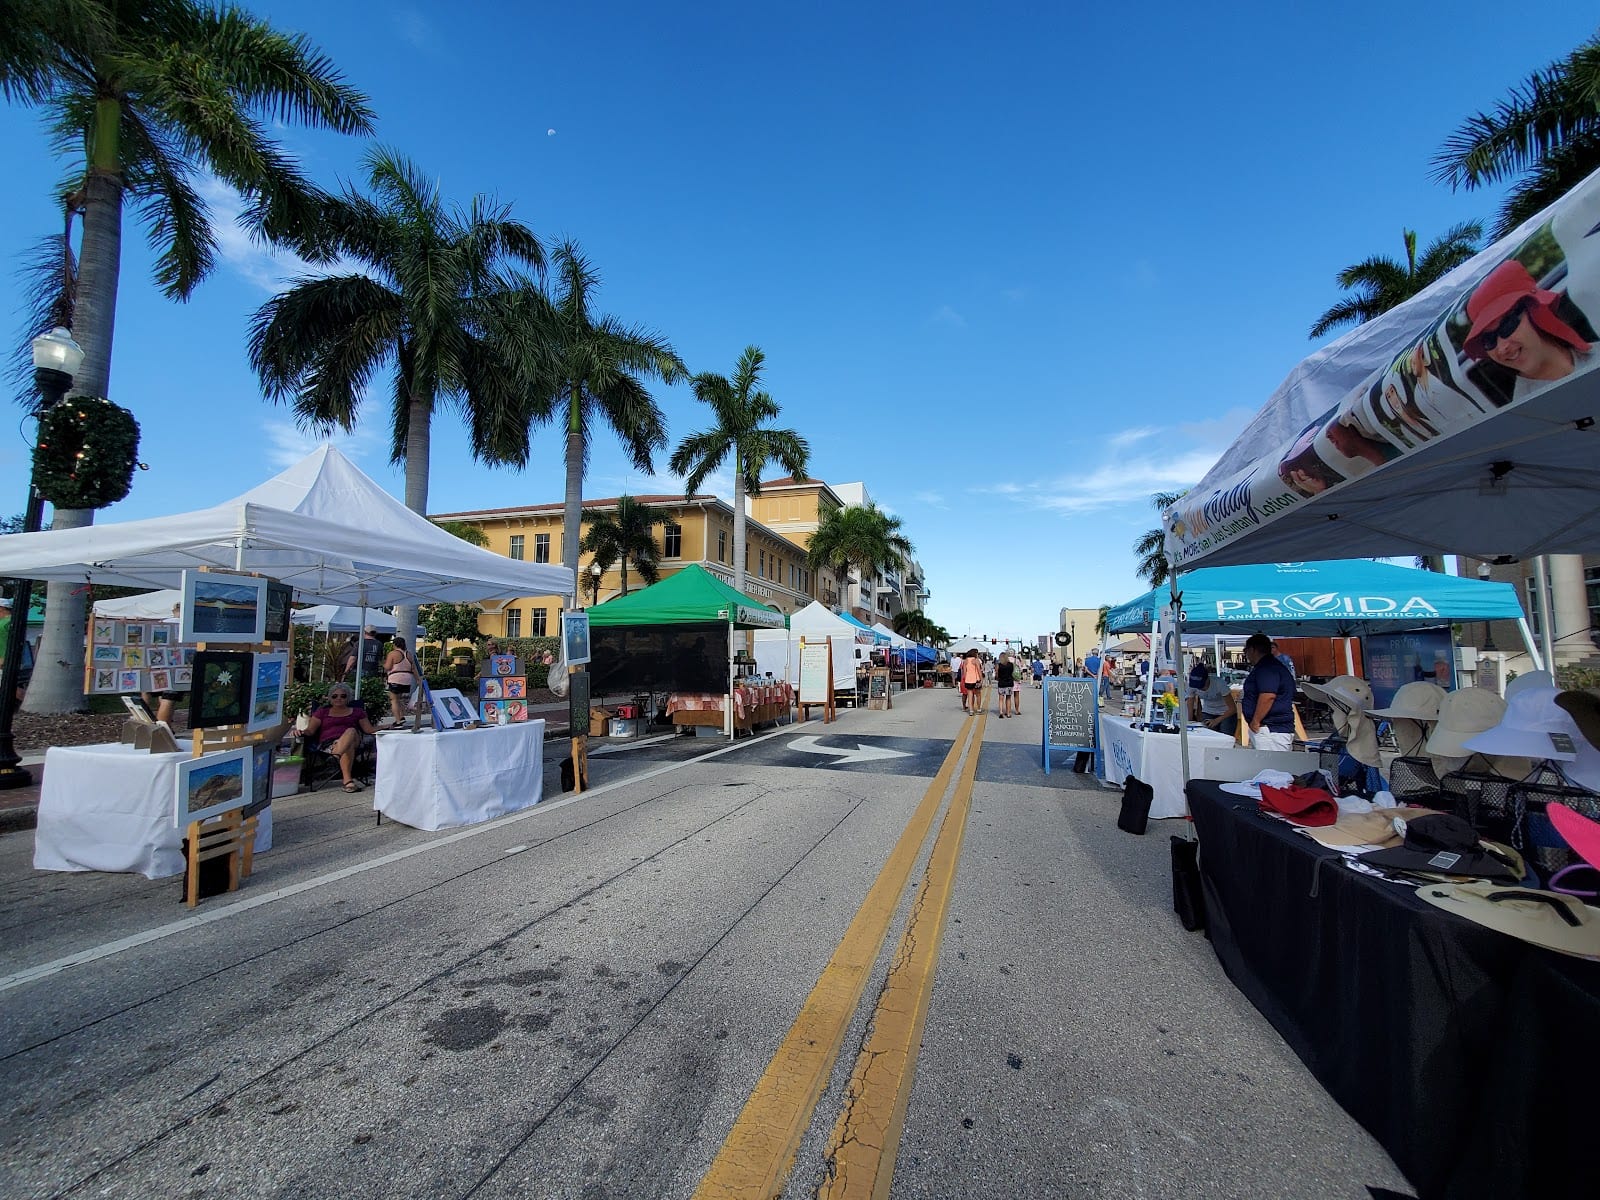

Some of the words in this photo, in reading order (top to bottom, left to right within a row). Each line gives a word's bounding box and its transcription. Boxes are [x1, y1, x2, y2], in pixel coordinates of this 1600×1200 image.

[1225, 515, 1254, 537] Suntan
[1254, 492, 1299, 518] Lotion
[1217, 612, 1307, 620] CANNABINOID
[1047, 681, 1092, 695] PROVIDA
[1055, 692, 1084, 704] HEMP
[1056, 702, 1083, 713] CBD
